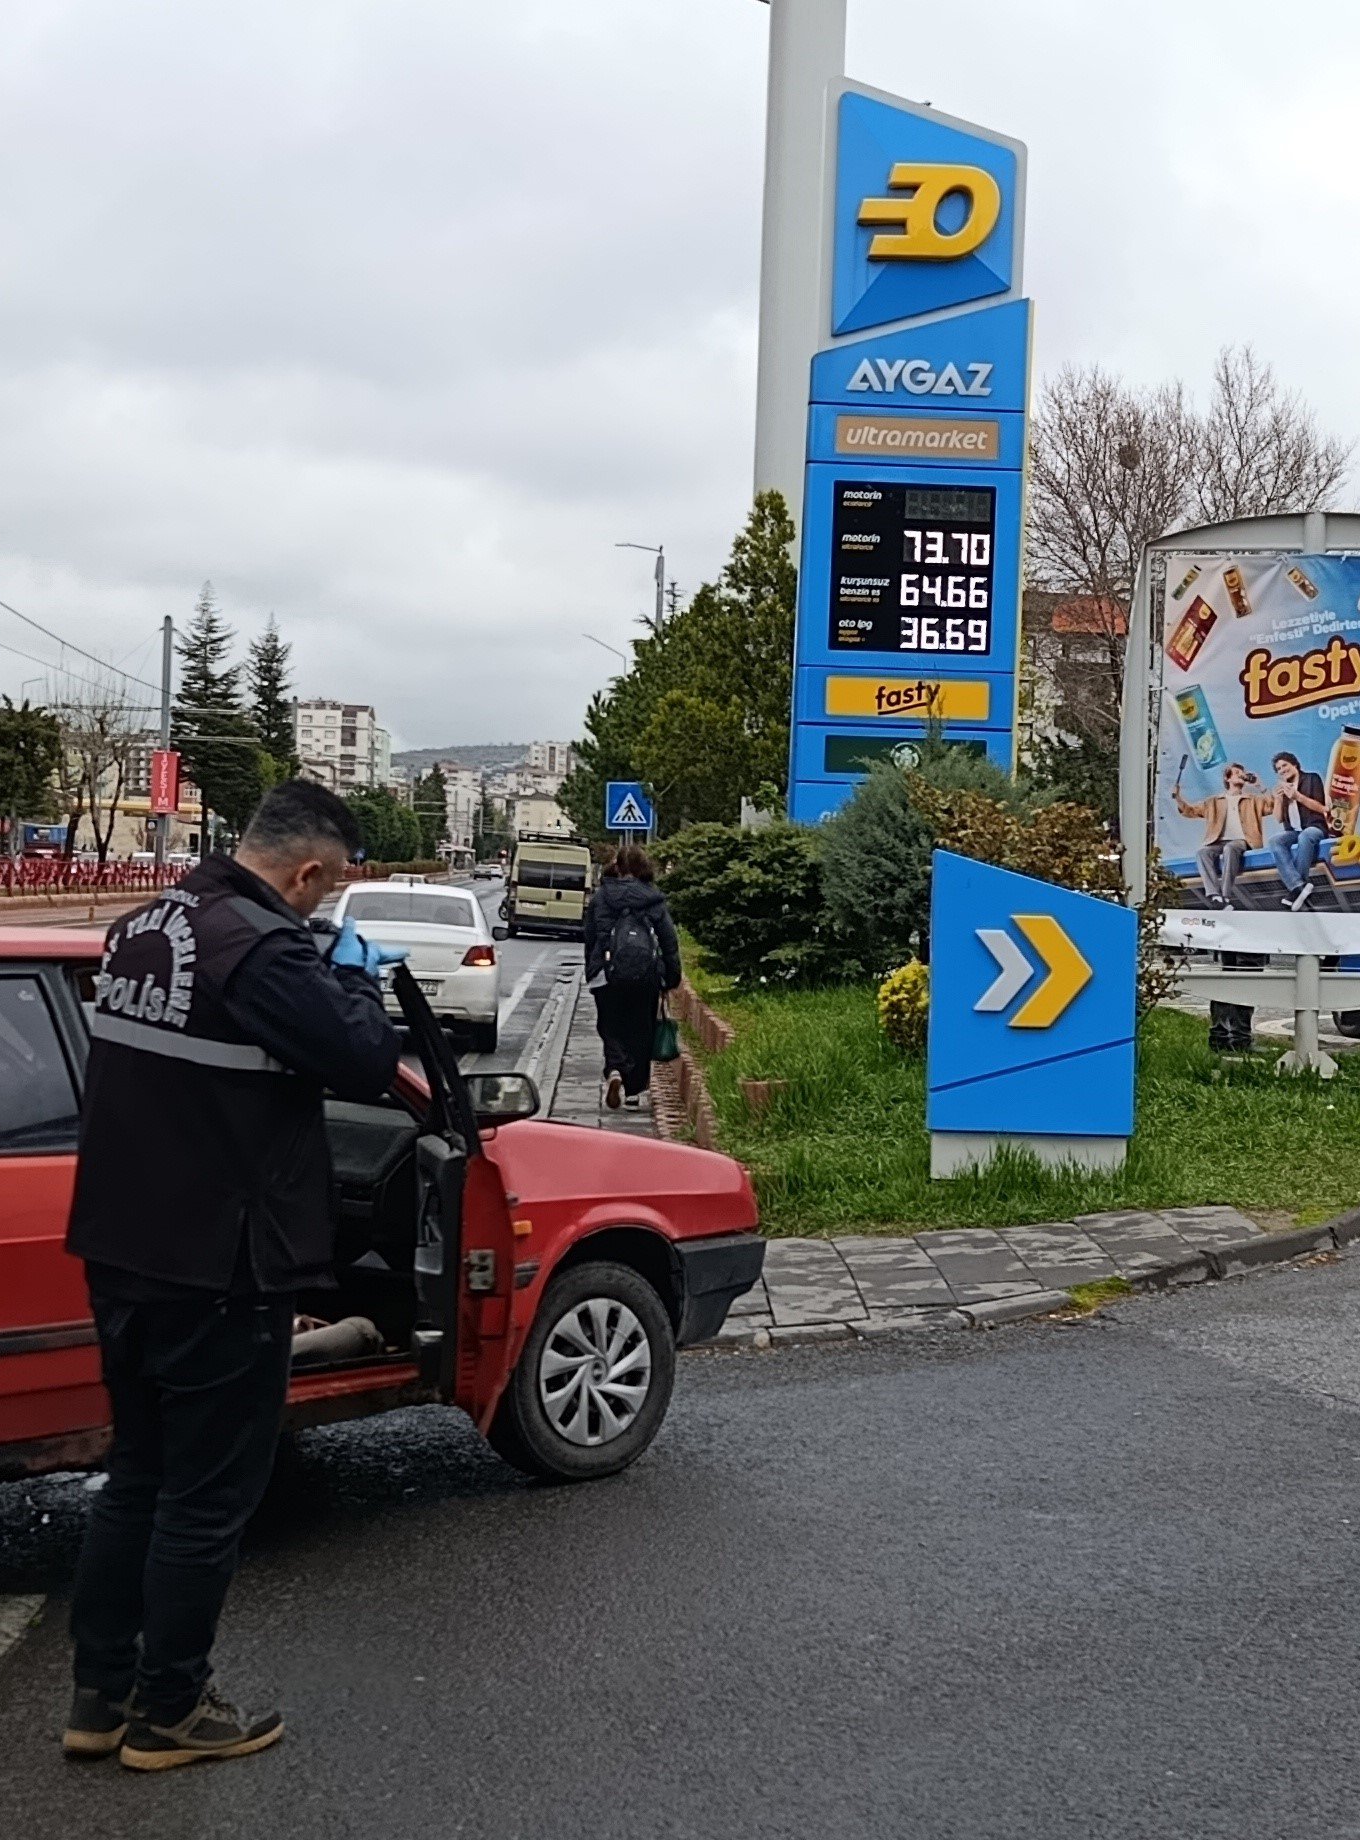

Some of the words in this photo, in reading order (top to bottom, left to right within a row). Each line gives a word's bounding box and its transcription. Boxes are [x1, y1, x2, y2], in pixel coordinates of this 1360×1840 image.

[845, 357, 994, 397] AYGAZ
[846, 425, 988, 450] ultramarket
[843, 490, 882, 500] motorin
[841, 533, 881, 543] motorin
[903, 530, 990, 566] 73.70
[900, 573, 988, 608] 64.66
[900, 616, 987, 651] 36.69
[875, 680, 941, 715] fasty
[93, 973, 167, 1022] POLİS
